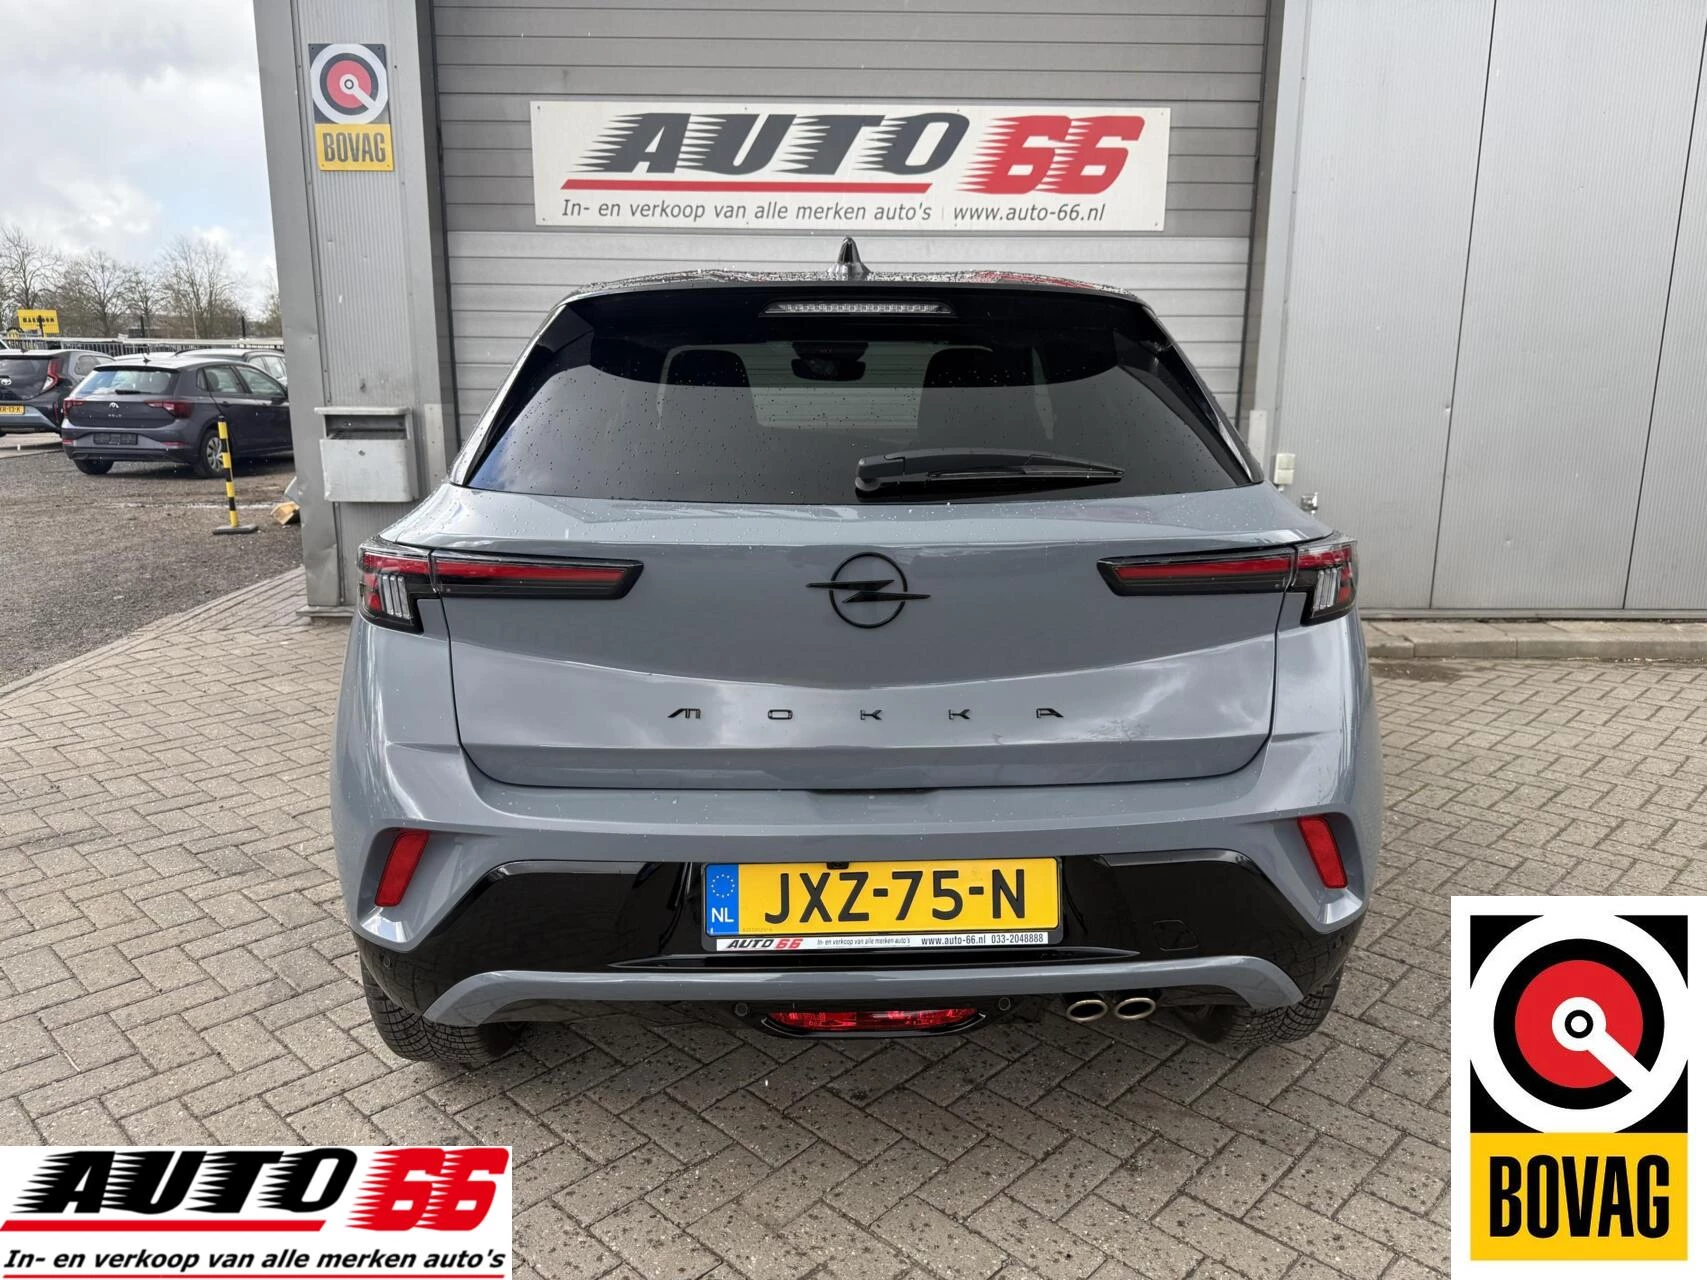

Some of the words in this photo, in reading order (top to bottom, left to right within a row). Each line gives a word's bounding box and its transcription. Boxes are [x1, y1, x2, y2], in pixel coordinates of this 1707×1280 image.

[322, 132, 387, 163] BOVAG
[565, 111, 970, 176] AUTO
[955, 115, 1146, 195] 66
[561, 199, 590, 217] In-
[598, 204, 621, 217] en
[630, 201, 706, 222] verkoop
[714, 204, 747, 219] van
[754, 201, 789, 220] alle
[796, 202, 866, 221] merken
[874, 203, 932, 221] auto's
[953, 203, 1106, 222] www.auto-66.nl
[667, 707, 1064, 721] MOKKA
[764, 868, 1025, 925] JXZ-75-N
[711, 907, 735, 923] NL
[727, 939, 775, 949] AUTO
[775, 938, 804, 949] 66
[833, 938, 854, 946] verkoop
[921, 934, 987, 946] www.auto-66.nl
[991, 933, 1044, 944] 033-2048888
